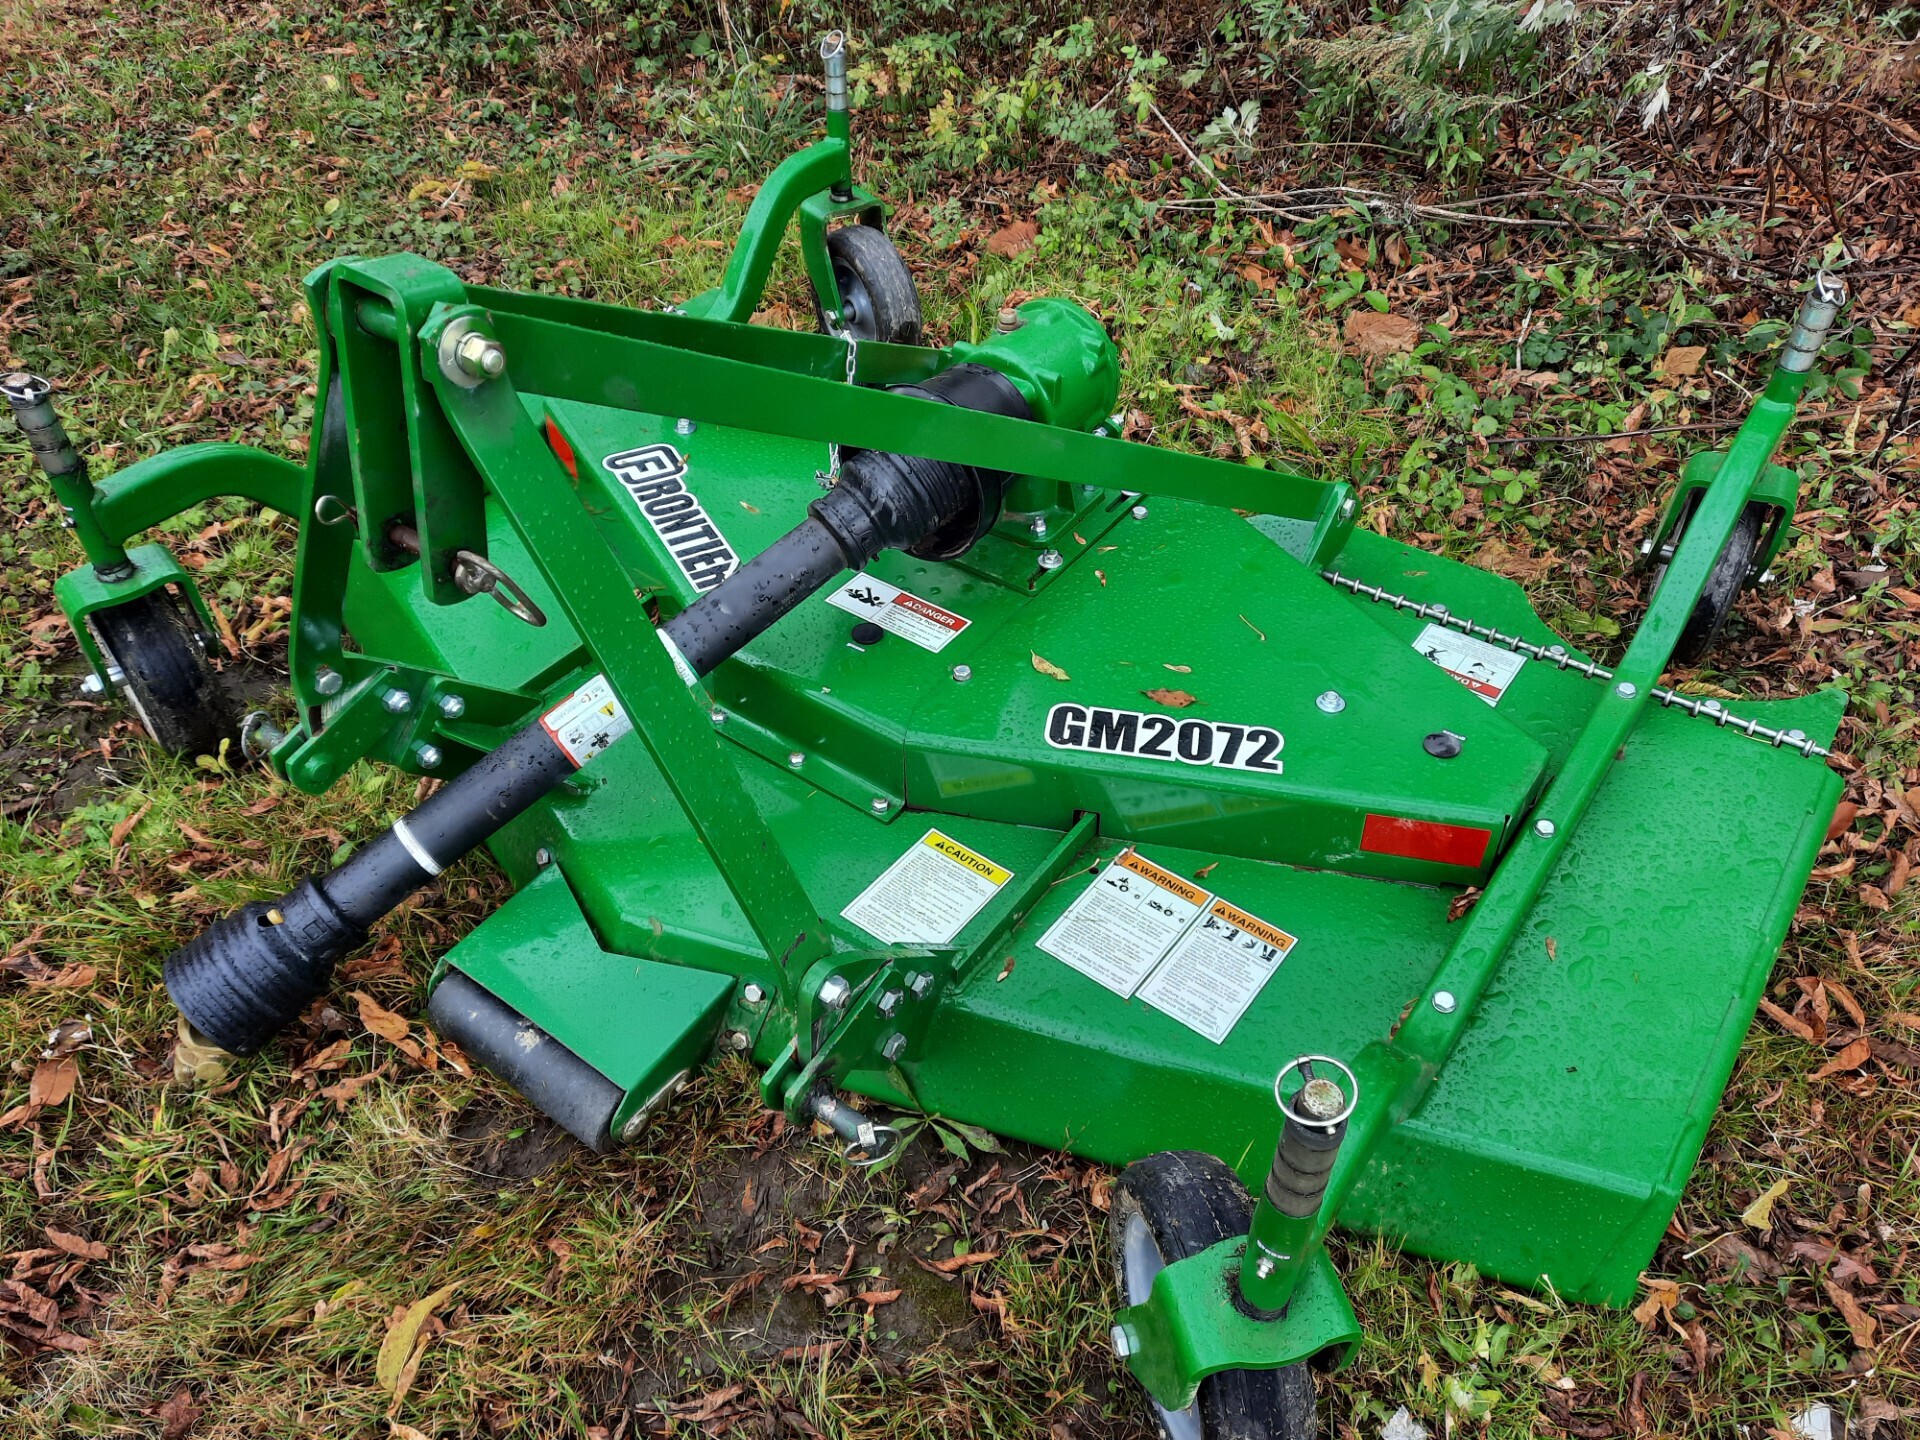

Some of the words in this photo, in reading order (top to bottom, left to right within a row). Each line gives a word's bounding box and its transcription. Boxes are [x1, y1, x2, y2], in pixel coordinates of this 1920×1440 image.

[910, 602, 957, 626] DANGER
[1048, 705, 1280, 771] GM2072
[943, 844, 994, 876] CAUTION
[1137, 865, 1197, 900] WARNING
[1225, 910, 1287, 948] WARNING
